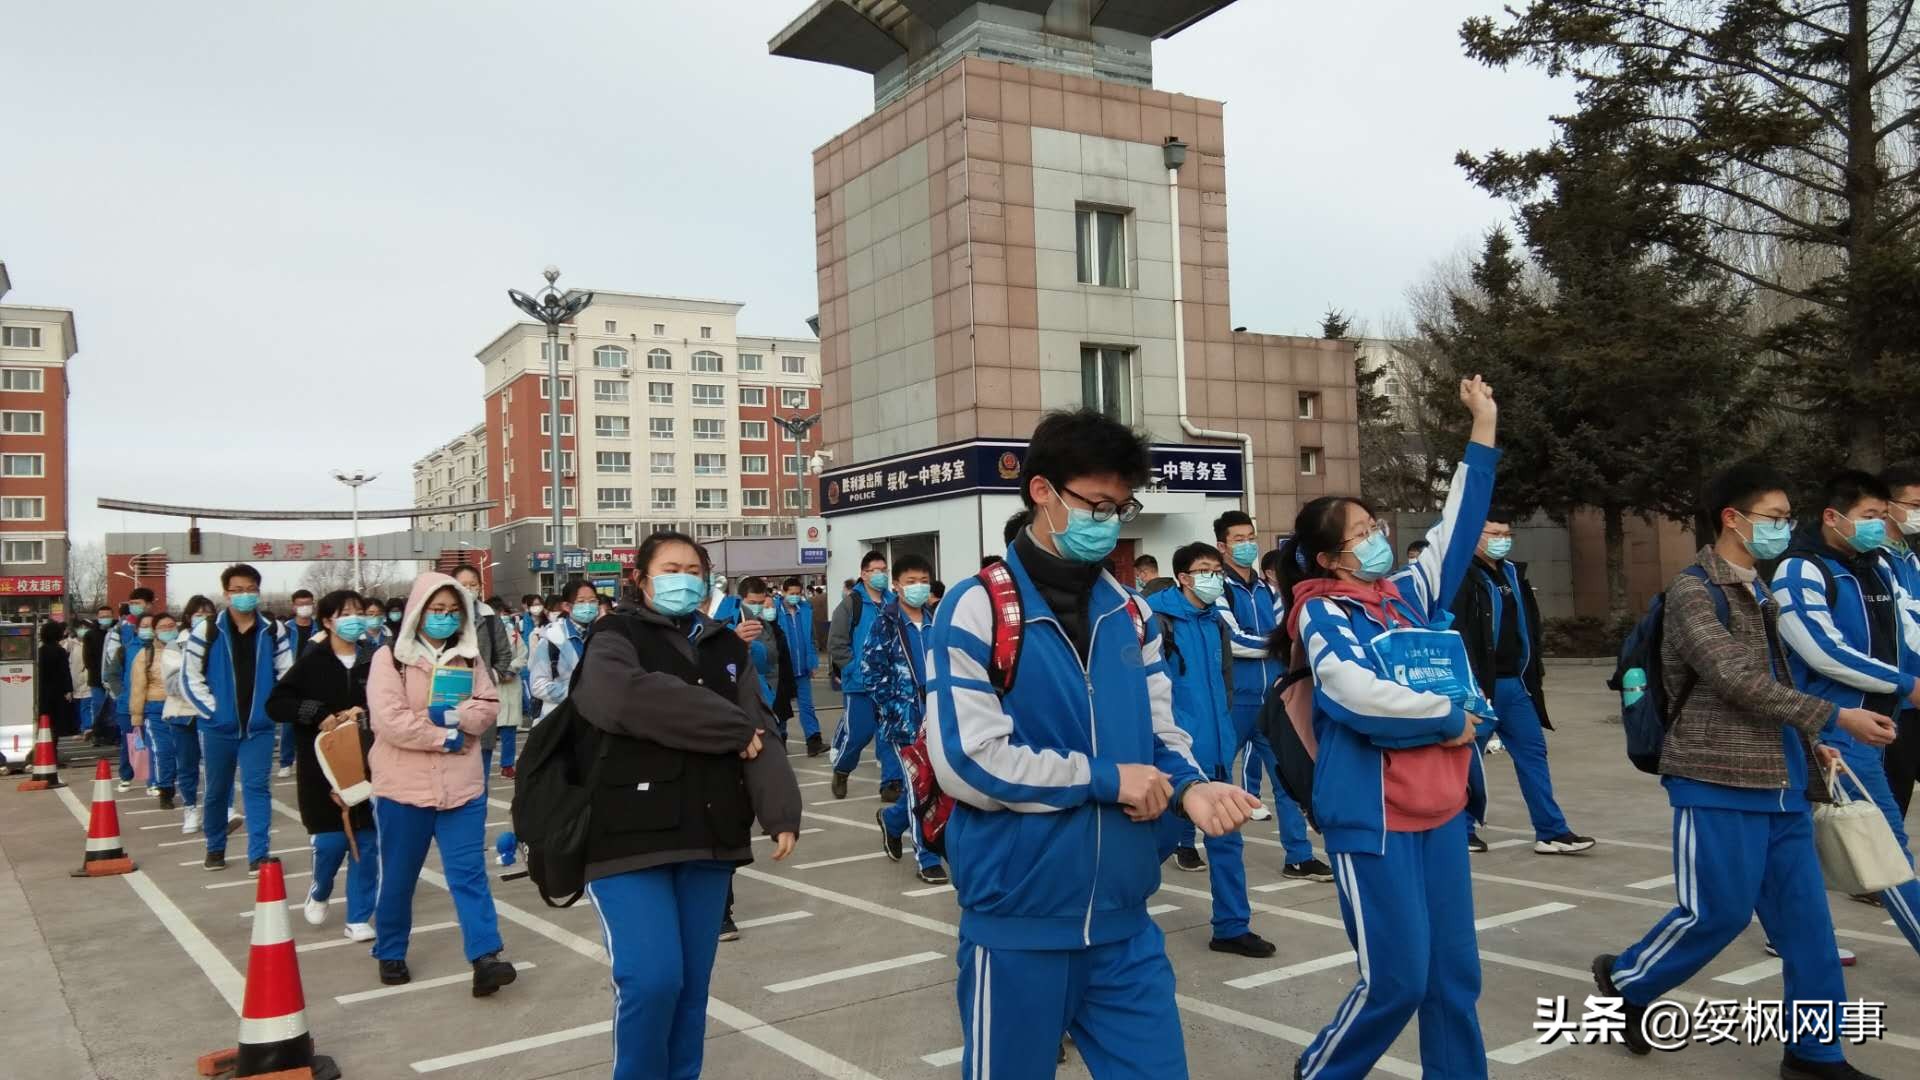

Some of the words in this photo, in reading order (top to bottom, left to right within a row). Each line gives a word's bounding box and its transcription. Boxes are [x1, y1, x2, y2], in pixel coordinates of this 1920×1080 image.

[842, 471, 883, 493] 胜利派出所
[887, 459, 966, 491] 绥化一中警务室
[850, 491, 876, 502] POLICE
[17, 579, 62, 592] 校友超市
